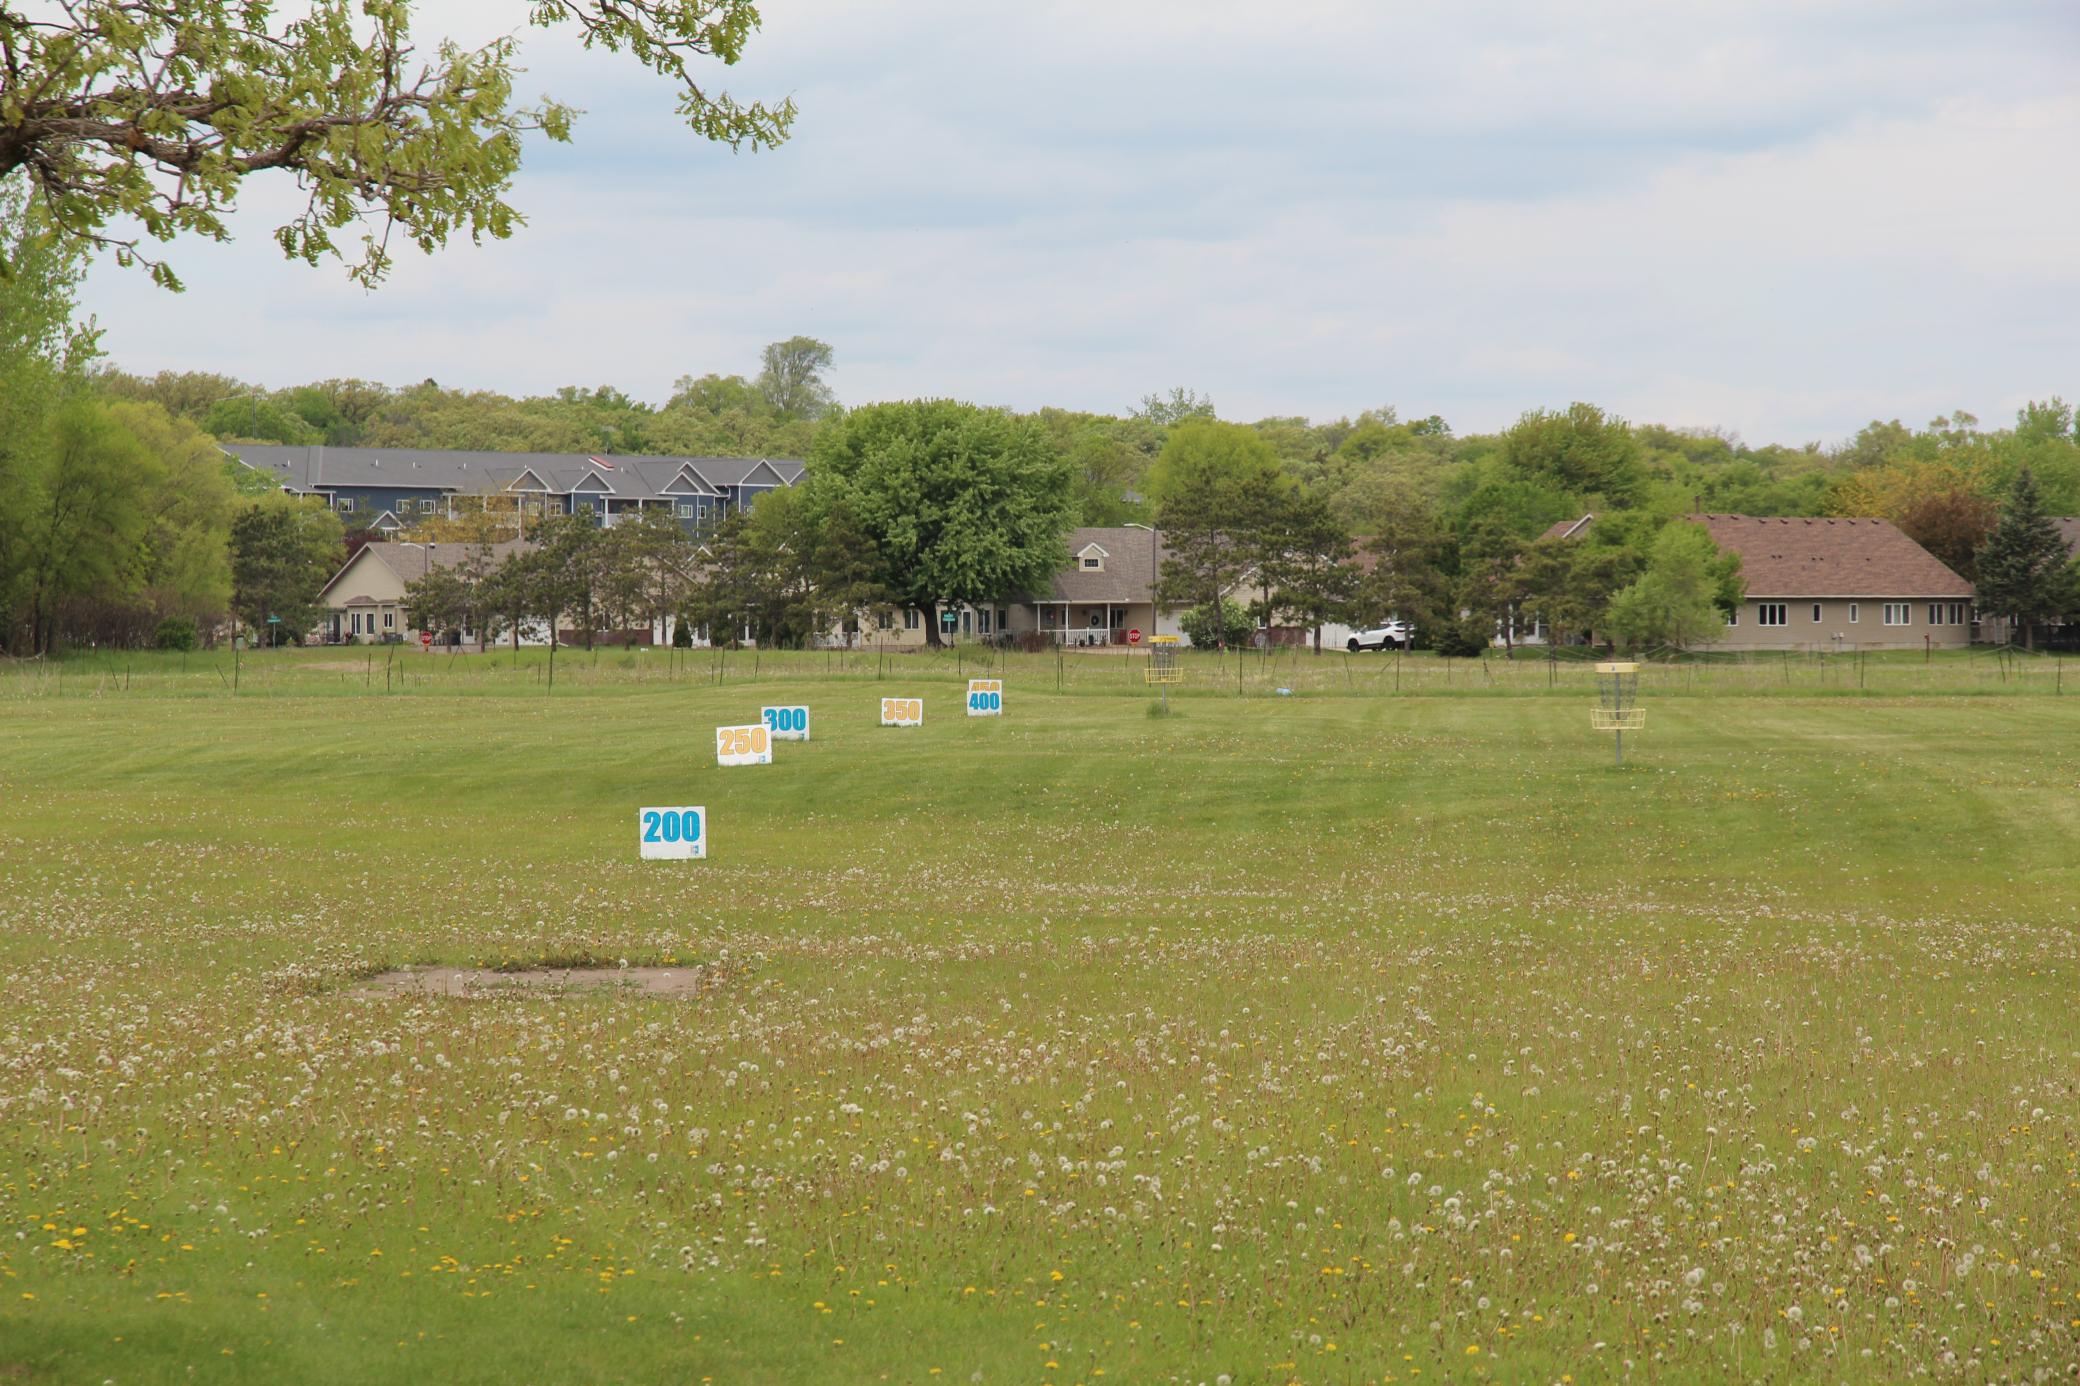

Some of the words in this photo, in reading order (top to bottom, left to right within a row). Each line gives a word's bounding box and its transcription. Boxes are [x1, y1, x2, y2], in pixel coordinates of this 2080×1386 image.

[883, 700, 920, 721] 350
[969, 692, 1000, 710] 400
[764, 708, 806, 731] 300
[720, 728, 766, 755] 250
[644, 811, 700, 842] 200
